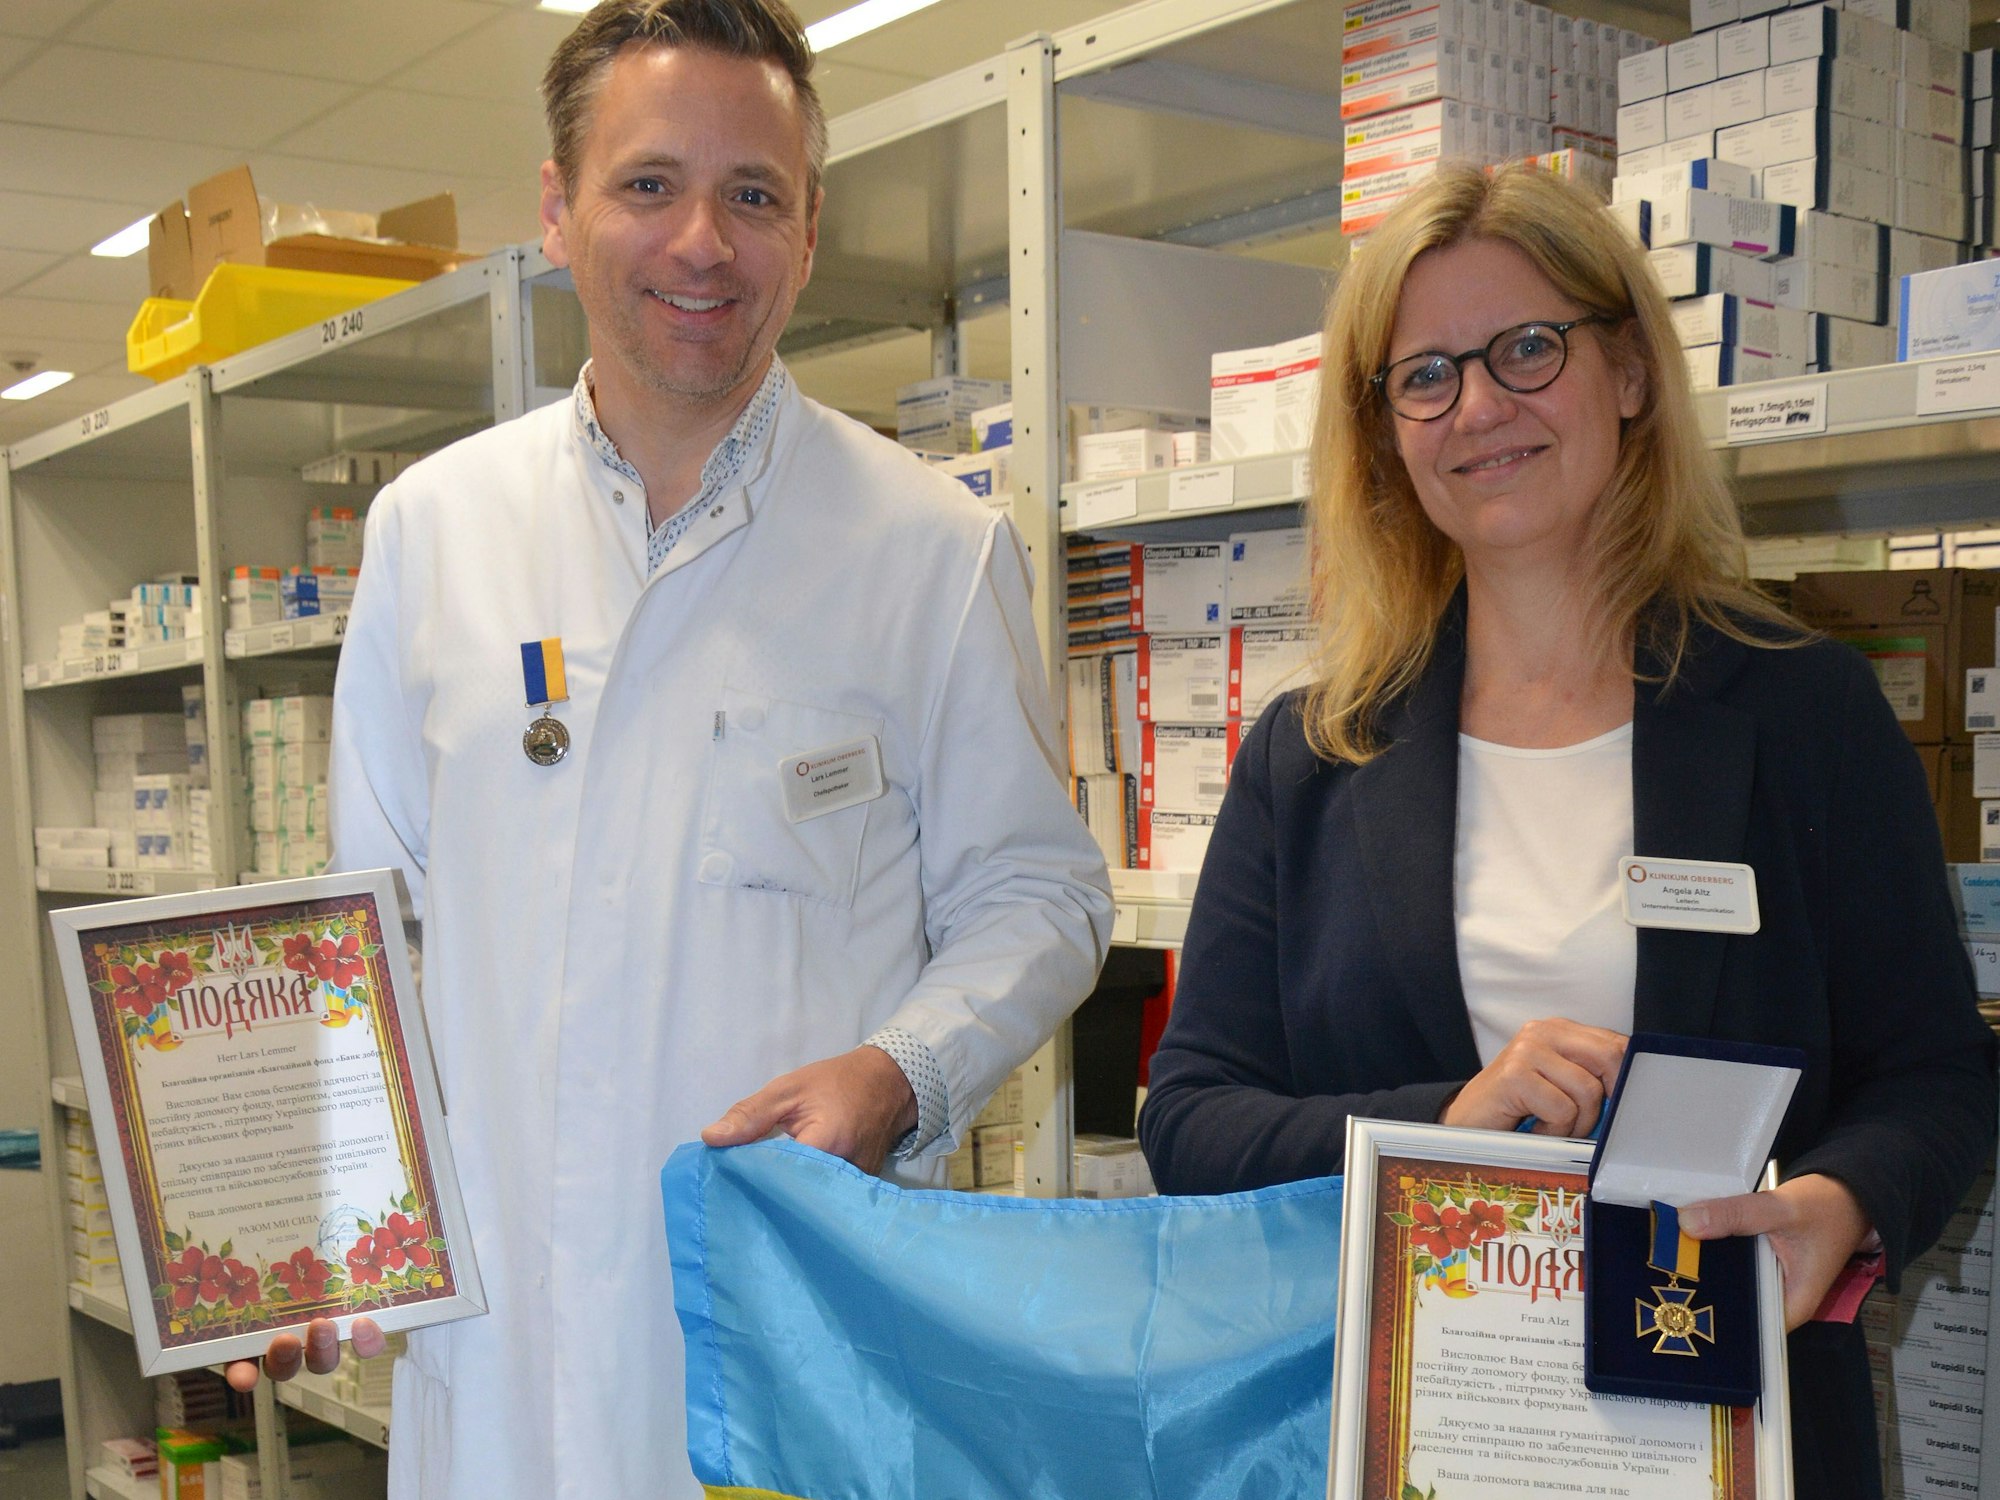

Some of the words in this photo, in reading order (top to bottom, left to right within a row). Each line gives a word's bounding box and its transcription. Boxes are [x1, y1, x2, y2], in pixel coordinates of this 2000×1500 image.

[322, 321, 337, 344] 20
[342, 311, 364, 337] 240
[1730, 405, 1755, 415] Metex
[1759, 398, 1815, 412] 7,5mg/0,15ml
[81, 418, 91, 436] 20
[94, 410, 109, 430] 220
[1730, 415, 1781, 428] Fertigspritze
[1145, 547, 1182, 560] Clopidogrel
[1151, 638, 1186, 650] Clopidogrel
[94, 658, 104, 673] 20
[107, 654, 121, 670] 221
[1156, 727, 1193, 738] Clopidogrel
[810, 756, 836, 770] KLINIKUM
[837, 748, 866, 762] OBERBERG
[811, 775, 824, 783] Lars
[825, 766, 849, 779] Lemmer
[1153, 813, 1188, 825] Clopidogrel
[107, 873, 116, 889] 20
[119, 873, 134, 889] 222
[1649, 872, 1689, 882] KLINIKUM
[1690, 875, 1734, 885] OBERBERG
[1662, 886, 1692, 896] Angela
[1694, 888, 1711, 896] Altz
[1676, 897, 1700, 905] Leiterin
[1641, 903, 1736, 915] Unternehmenskommunikation
[176, 972, 314, 1040] ПОДЯКА
[217, 1053, 238, 1063] Herr
[239, 1050, 260, 1061] Lars
[261, 1044, 297, 1057] Lemmer
[313, 1056, 334, 1069] фонд
[166, 1096, 219, 1111] Висловлює
[222, 1091, 243, 1102] Вам
[244, 1088, 271, 1099] слова
[272, 1079, 322, 1094] безмежної
[323, 1072, 370, 1087] вдячності
[372, 1071, 381, 1080] за
[148, 1111, 191, 1126] постійну
[193, 1105, 240, 1121] допомогу
[150, 1122, 217, 1138] небайдужість
[224, 1113, 274, 1129] підтримку
[274, 1104, 338, 1120] Українського
[340, 1099, 373, 1112] народу
[374, 1096, 385, 1105] та
[153, 1138, 186, 1152] різних
[187, 1132, 240, 1146] військових
[241, 1122, 294, 1140] формувань
[178, 1160, 221, 1174] Дякуємо
[223, 1158, 234, 1167] за
[235, 1151, 274, 1164] надання
[275, 1141, 337, 1160] гуманітарної
[338, 1134, 384, 1149] допомоги
[385, 1131, 390, 1141] і
[161, 1176, 198, 1190] спільну
[200, 1168, 252, 1184] співпрацю
[253, 1165, 266, 1174] по
[268, 1155, 333, 1171] забезпеченню
[335, 1146, 387, 1161] цивільного
[215, 1184, 227, 1193] та
[228, 1168, 329, 1192] військовослужбовців
[330, 1161, 369, 1175] України
[187, 1208, 215, 1220] Ваша
[217, 1202, 263, 1216] допомога
[264, 1196, 304, 1210] важлива
[306, 1192, 324, 1205] для
[325, 1188, 341, 1198] нас
[238, 1221, 271, 1235] РАЗОМ
[272, 1219, 290, 1230] МИ
[291, 1215, 320, 1228] СИЛА
[1481, 1240, 1585, 1304] ПОДЯ
[1935, 1282, 1971, 1295] Urapidil
[1520, 1313, 1545, 1326] Frau
[1547, 1315, 1571, 1327] Alzt
[1933, 1321, 1968, 1334] Urapidil
[1441, 1326, 1496, 1342] Благодійна
[1498, 1333, 1556, 1348] організація
[1440, 1348, 1507, 1366] Висловлює
[1509, 1355, 1534, 1367] Вам
[1536, 1359, 1571, 1371] слова
[1930, 1360, 1965, 1373] Urapidil
[1415, 1359, 1469, 1377] постійну
[1471, 1365, 1529, 1382] допомогу
[1415, 1373, 1496, 1392] небайдужість
[1505, 1381, 1566, 1400] підтримку
[1415, 1385, 1454, 1404] різних
[1456, 1389, 1521, 1407] військових
[1523, 1396, 1589, 1414] формувань
[1928, 1399, 1963, 1412] Urapidil
[1438, 1415, 1491, 1432] Дякуємо
[1492, 1422, 1506, 1432] за
[1508, 1423, 1557, 1438] надання
[1559, 1427, 1637, 1447] гуманітарної
[1638, 1435, 1697, 1452] допомоги
[1699, 1438, 1705, 1452] і
[1926, 1437, 1961, 1450] Urapidil
[1413, 1427, 1460, 1444] спільну
[1461, 1432, 1527, 1450] співпрацю
[1528, 1438, 1544, 1449] по
[1545, 1439, 1629, 1458] забезпеченню
[1630, 1448, 1698, 1464] цивільного
[1412, 1442, 1474, 1458] населення
[1475, 1448, 1491, 1458] та
[1493, 1447, 1620, 1472] військовослужбовців
[1621, 1460, 1671, 1476] України
[1437, 1467, 1471, 1481] Ваша
[1473, 1472, 1530, 1488] допомога
[1533, 1477, 1583, 1492] важлива
[1584, 1483, 1608, 1497] для
[1609, 1486, 1631, 1497] нас
[1925, 1476, 1959, 1489] Urapidil
